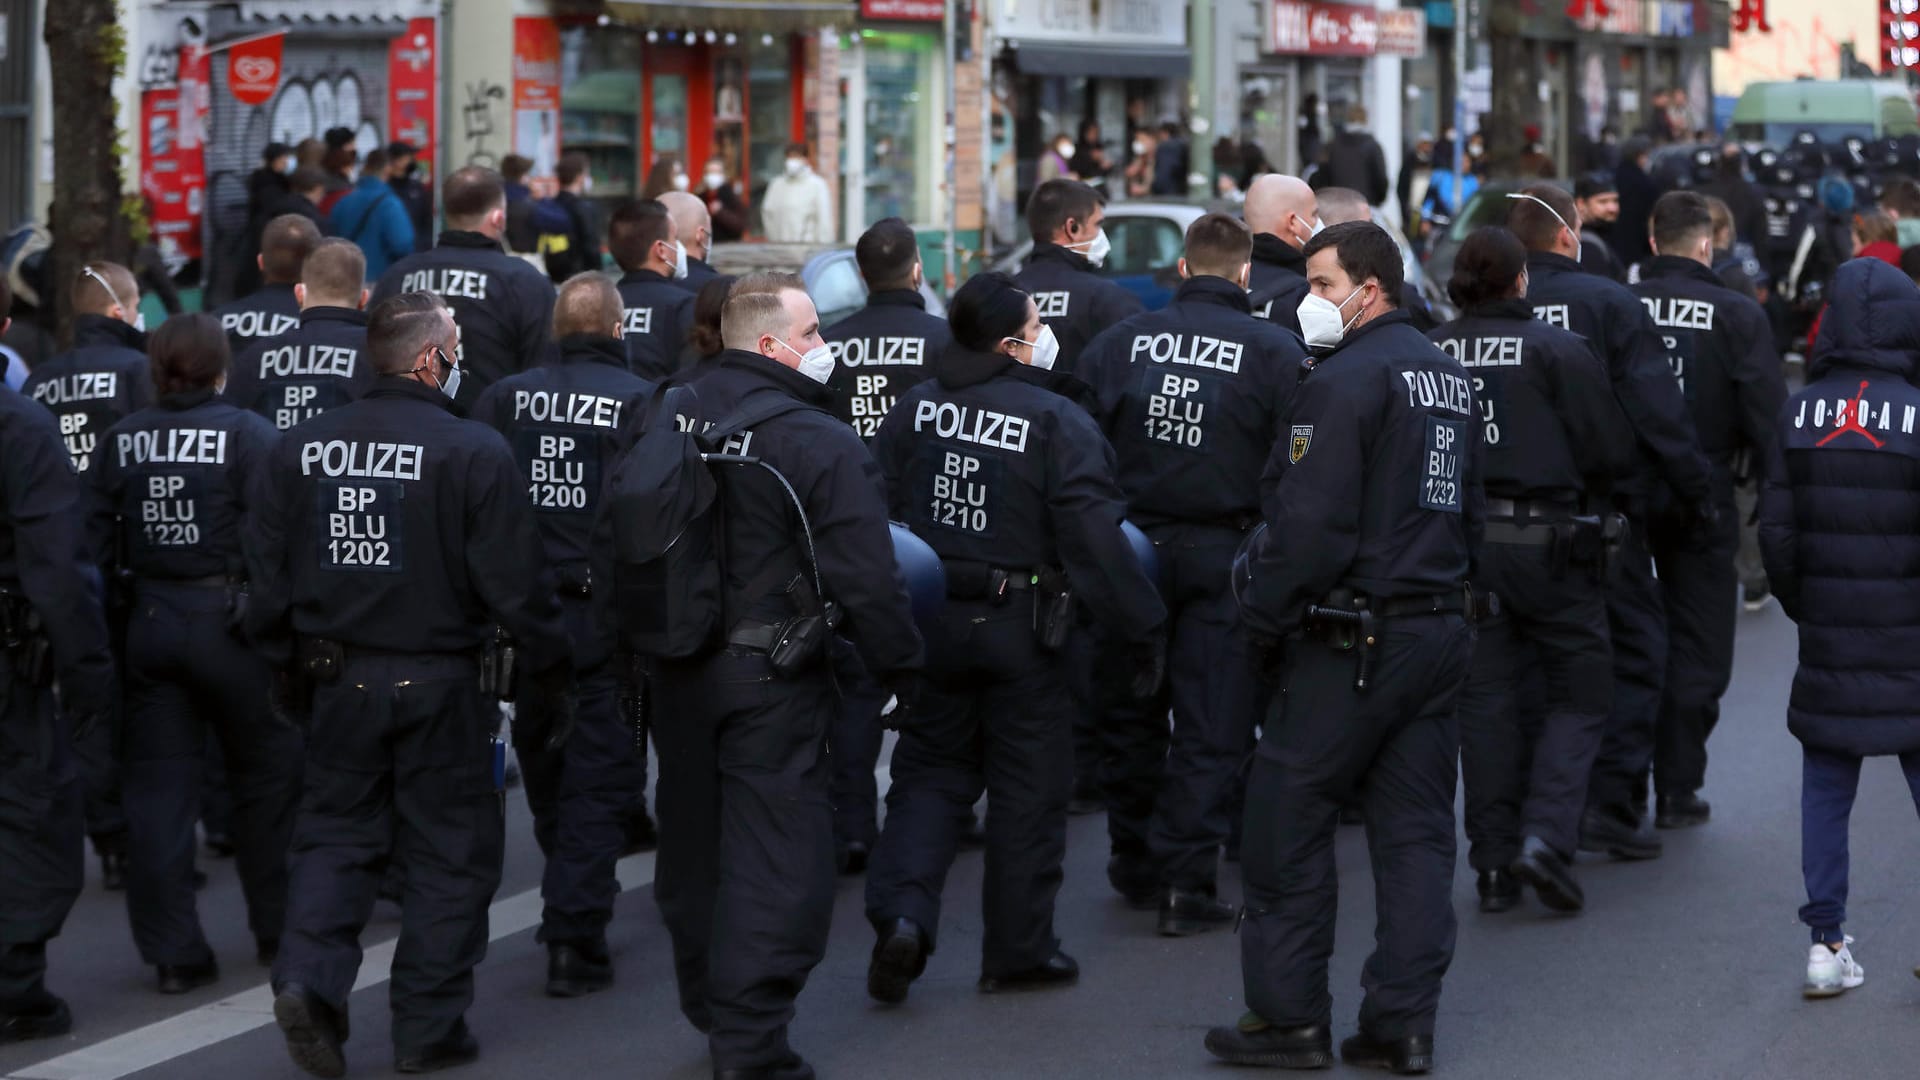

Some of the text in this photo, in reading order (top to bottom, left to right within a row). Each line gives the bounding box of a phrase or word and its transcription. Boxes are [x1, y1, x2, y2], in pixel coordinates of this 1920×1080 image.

[401, 269, 487, 300] POLIZEI
[221, 311, 300, 337] POLIZ
[259, 345, 357, 380] POLIZEI
[828, 337, 925, 368] POLIZEI
[1130, 333, 1244, 374] POLIZEI
[1433, 337, 1523, 368] OLIZEI
[32, 372, 117, 405] POLIZEI
[284, 386, 318, 407] BP
[857, 375, 888, 395] BP
[1162, 374, 1200, 398] BP
[1401, 370, 1471, 416] POLIZEI
[514, 390, 623, 429] POLIZEI
[851, 396, 896, 416] BLU
[1148, 395, 1204, 424] BLU
[1794, 398, 1917, 434] JORDAN
[60, 412, 88, 435] BP
[914, 400, 1030, 453] POLIZEI
[1144, 418, 1202, 448] 1210
[1436, 424, 1455, 451] BP
[64, 432, 96, 454] LU
[117, 428, 227, 467] POLIZEI
[539, 435, 576, 459] BP
[301, 439, 424, 481] POLIZEI
[531, 459, 584, 485] BLU
[944, 452, 981, 480] BP
[1428, 450, 1456, 479] BLU
[149, 476, 186, 499] BP
[338, 487, 377, 512] BP
[528, 483, 587, 509] 1200
[933, 474, 987, 507] BLU
[1426, 478, 1456, 506] 1232
[142, 500, 195, 522] BLU
[930, 499, 988, 532] 1210
[144, 523, 200, 545] 1220
[329, 513, 386, 539] BLU
[328, 539, 390, 566] 1202
